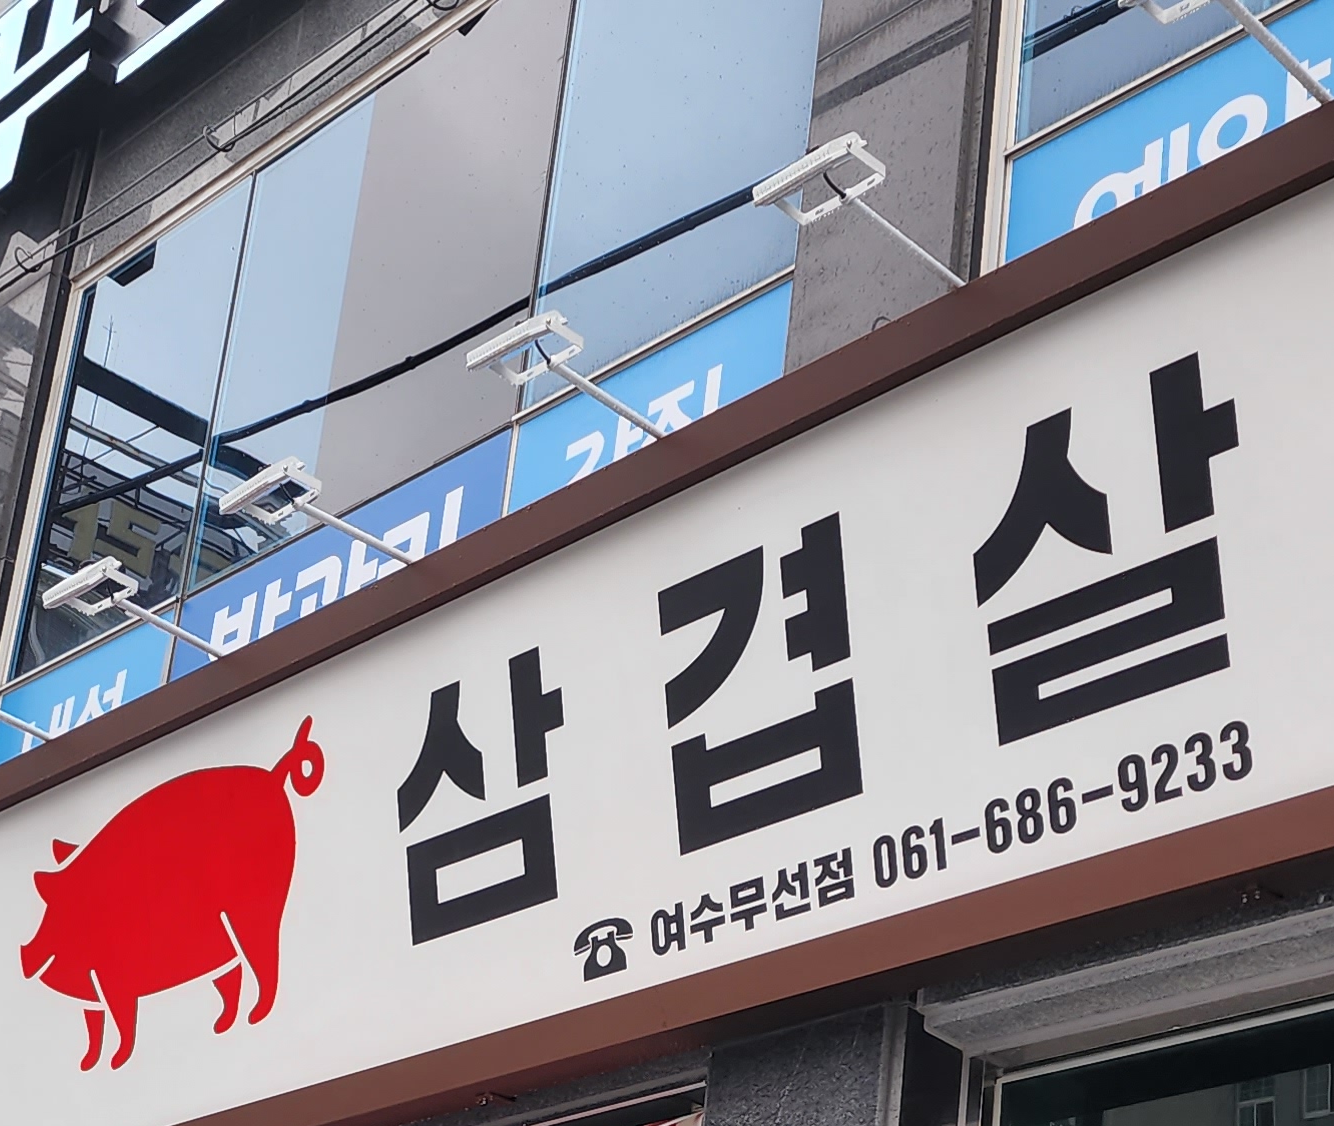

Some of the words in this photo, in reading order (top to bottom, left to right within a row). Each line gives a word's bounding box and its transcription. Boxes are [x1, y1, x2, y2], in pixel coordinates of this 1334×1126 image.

[396, 351, 1240, 946] 삼겹살
[649, 846, 856, 956] 여수무선점
[872, 720, 1254, 890] 061-686-9233
